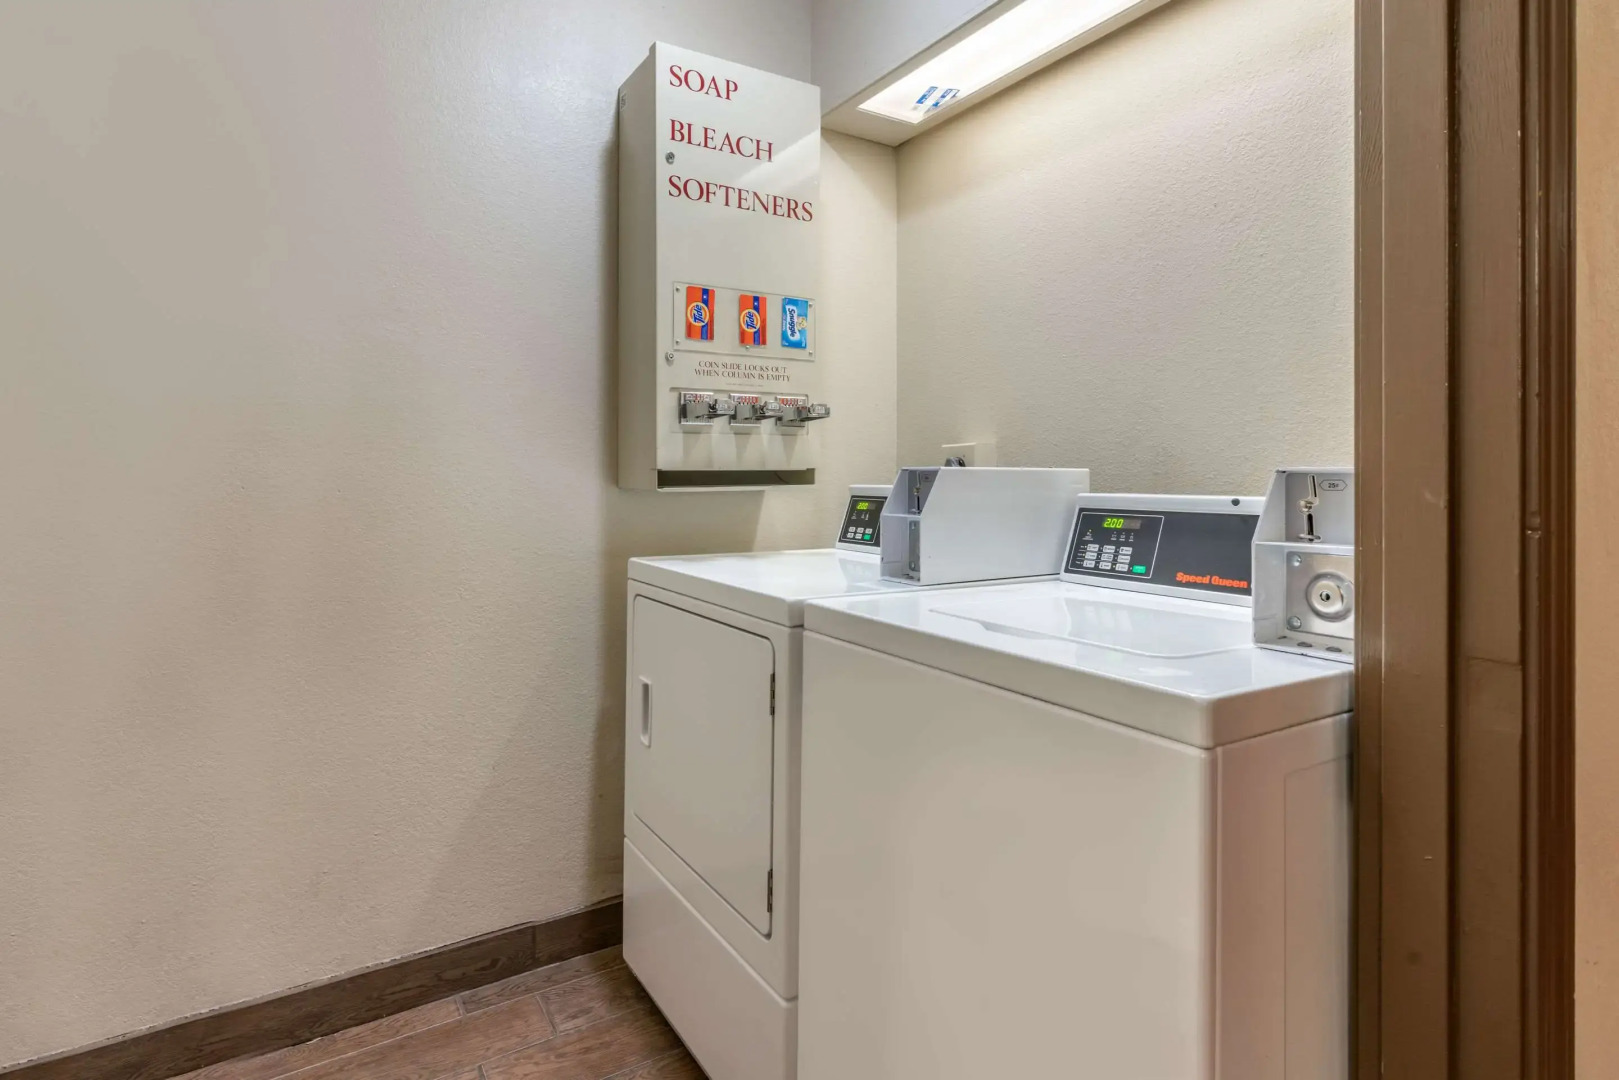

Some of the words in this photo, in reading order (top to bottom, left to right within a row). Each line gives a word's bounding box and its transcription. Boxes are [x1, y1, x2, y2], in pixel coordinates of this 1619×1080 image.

[669, 65, 738, 101] SOAP
[669, 118, 773, 162] BLEACH
[668, 175, 813, 222] SOFTENERS
[692, 303, 706, 324] Tide
[745, 310, 757, 330] Tide
[787, 307, 797, 338] Snuggle
[694, 368, 720, 377] WHEN
[721, 370, 756, 379] COLUMN
[766, 374, 791, 382] EMPTY
[698, 360, 719, 368] COIN
[721, 362, 743, 370] SLIDE
[744, 364, 769, 372] LOCKS
[771, 366, 787, 374] OUT
[1175, 571, 1210, 584] Speed
[1211, 575, 1248, 589] Queen
